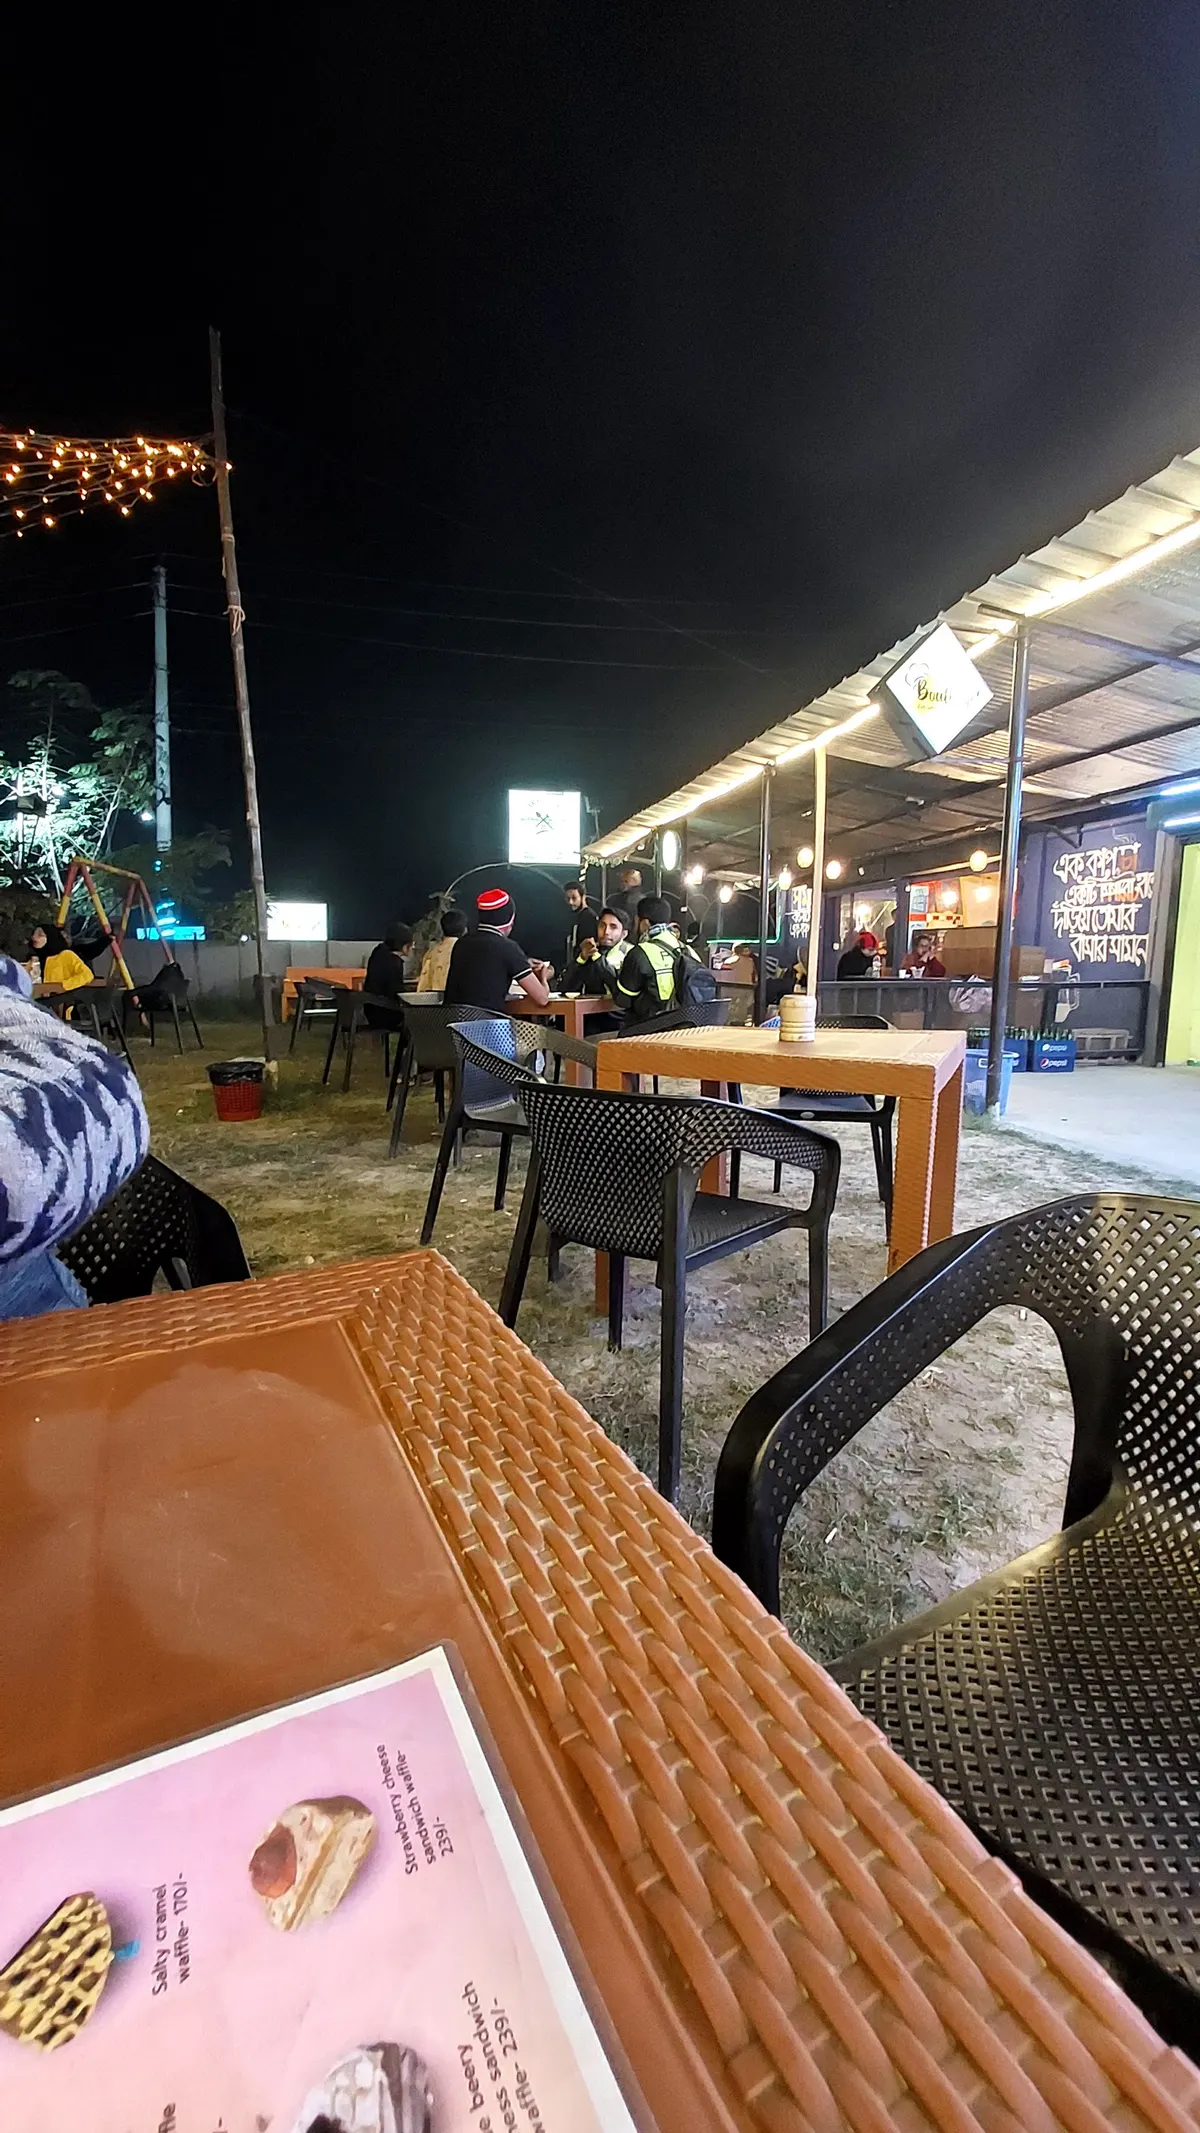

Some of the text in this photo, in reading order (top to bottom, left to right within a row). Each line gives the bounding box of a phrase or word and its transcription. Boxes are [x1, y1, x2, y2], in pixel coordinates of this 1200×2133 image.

[1053, 852, 1085, 884] এক
[1049, 1059, 1068, 1067] pepsi
[377, 1744, 418, 1875] Strawberry cheese
[407, 1796, 436, 1865] sandwich
[433, 1816, 454, 1856] 239/-
[172, 1872, 188, 1916] 170/-
[151, 1884, 171, 1996] Salty cramel
[461, 1980, 502, 2082] sandwich
[490, 1997, 518, 2058] 239/-
[457, 2044, 485, 2114] beery
